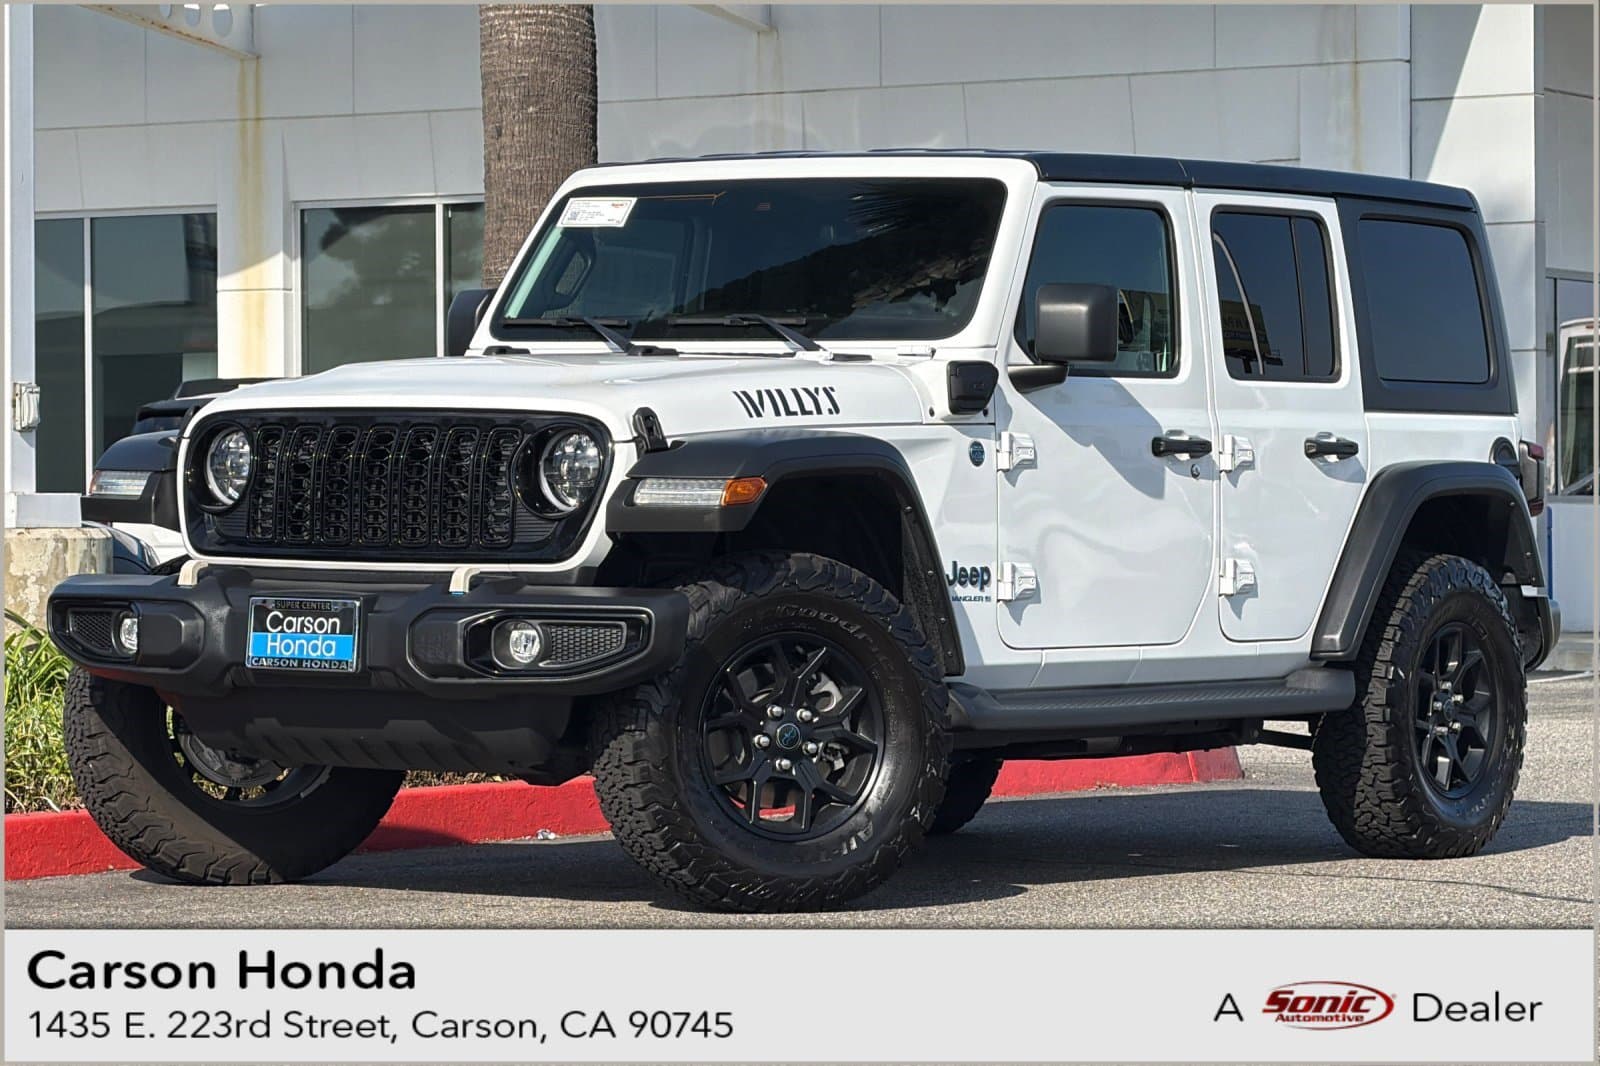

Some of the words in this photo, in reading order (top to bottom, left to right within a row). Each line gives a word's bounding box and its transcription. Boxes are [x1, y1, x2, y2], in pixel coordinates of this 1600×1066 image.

[732, 386, 840, 418] WILLYS
[945, 560, 991, 592] Jeep
[276, 600, 300, 609] SUPER
[301, 601, 331, 610] CENTER
[266, 611, 340, 634] Carson
[267, 633, 336, 657] Honda
[252, 657, 299, 668] CARSON
[302, 659, 349, 669] HONDA
